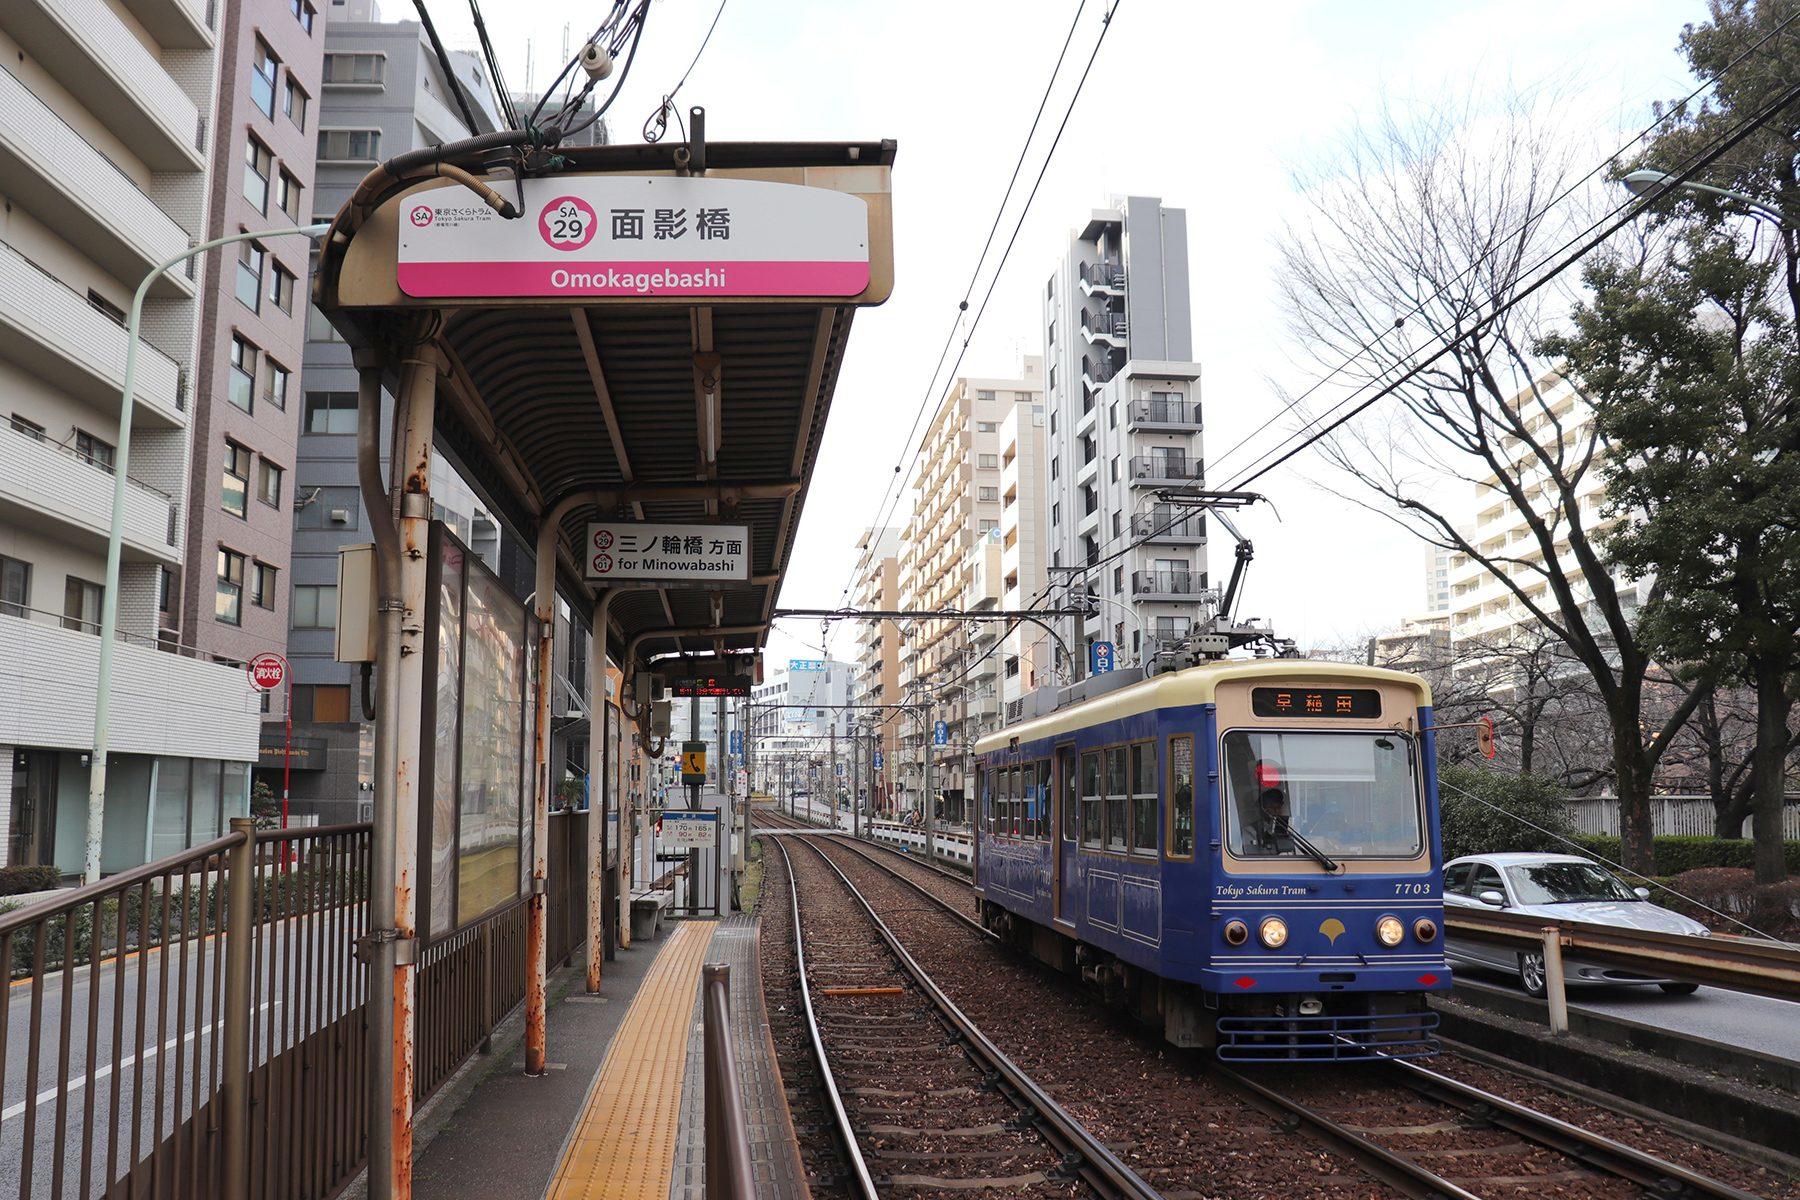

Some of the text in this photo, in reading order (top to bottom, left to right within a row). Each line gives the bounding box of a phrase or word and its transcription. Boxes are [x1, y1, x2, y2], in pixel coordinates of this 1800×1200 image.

[415, 212, 428, 221] SA
[434, 208, 492, 216] 東京さくらトラム
[559, 207, 578, 218] SA
[553, 219, 583, 239] 29
[610, 207, 731, 240] 面影橋
[550, 268, 726, 292] Omokagebashi
[618, 535, 742, 555] 三ノ輪橋 方面
[598, 561, 607, 569] 01
[617, 558, 734, 571] for Minowabashi
[256, 667, 281, 679] 消火栓
[1276, 693, 1352, 713] 早稲田
[1215, 884, 1307, 899] Tokyo Sakura Tram
[1394, 883, 1431, 895] 7703
